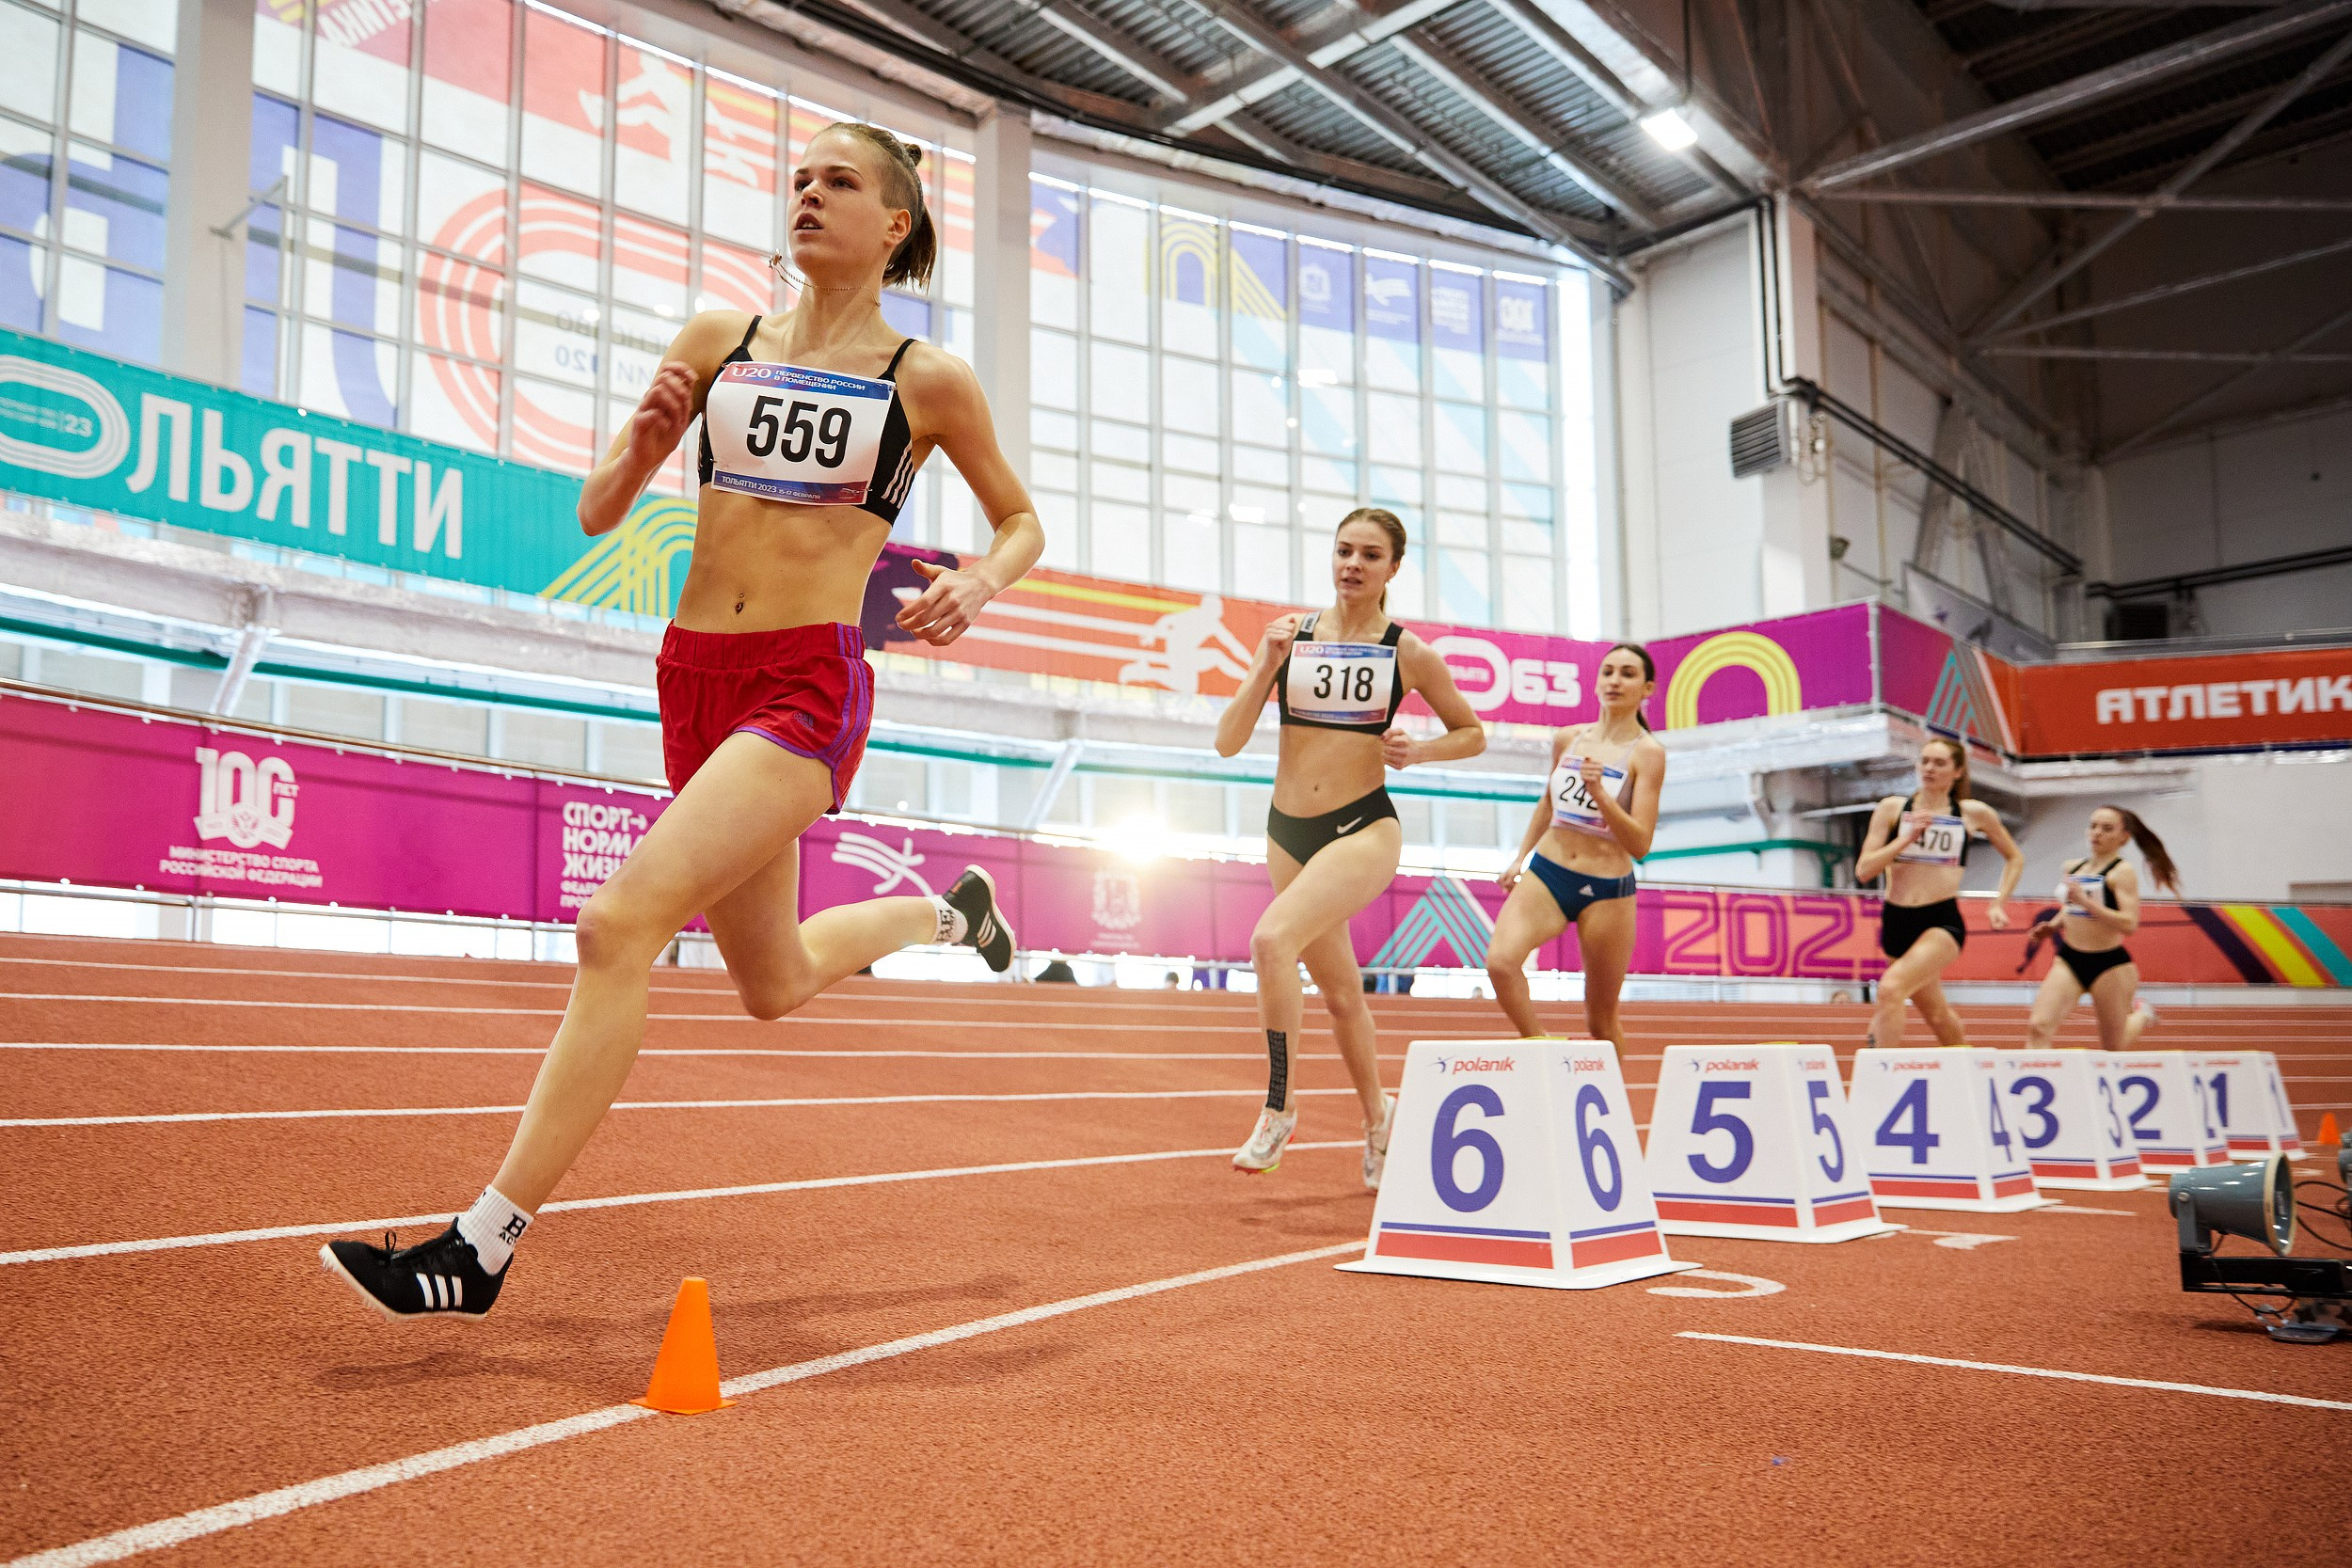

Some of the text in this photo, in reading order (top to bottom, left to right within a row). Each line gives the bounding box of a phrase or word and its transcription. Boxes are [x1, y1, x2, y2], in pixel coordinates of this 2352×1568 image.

[732, 367, 771, 379] U20
[775, 370, 866, 390] ПЕРВЕНСТВО РОССИИ
[781, 376, 836, 390] ПОМЕЩЕНИИ
[746, 395, 852, 468] 559
[722, 475, 758, 489] ТОЛЬЯТТИ
[757, 483, 777, 494] 2023
[792, 491, 821, 499] ФЕВРАЛЯ
[1299, 645, 1325, 654] U20
[1313, 664, 1375, 702] 318
[2095, 674, 2352, 725] АТЛЕТИК
[168, 846, 320, 873] МИНИСТЕРСТВО СПОРТА
[562, 826, 644, 857] НОРМ
[159, 859, 324, 888] РОССИЙСКОЙ ФЕДЕРАЦИИ
[1452, 1056, 1516, 1075] polanik
[1573, 1057, 1607, 1074] polanik
[1705, 1058, 1760, 1072] polanik
[1875, 1079, 1940, 1164] 4
[1989, 1077, 2013, 1163] 4
[2010, 1076, 2059, 1148] 3
[2098, 1076, 2122, 1148] 3
[2118, 1076, 2162, 1140] 2
[2193, 1074, 2217, 1139] 2
[2209, 1072, 2229, 1128] 1
[1431, 1084, 1505, 1213] 6
[1575, 1084, 1623, 1212] 6
[1687, 1081, 1754, 1183] 5
[1806, 1080, 1844, 1183] 5
